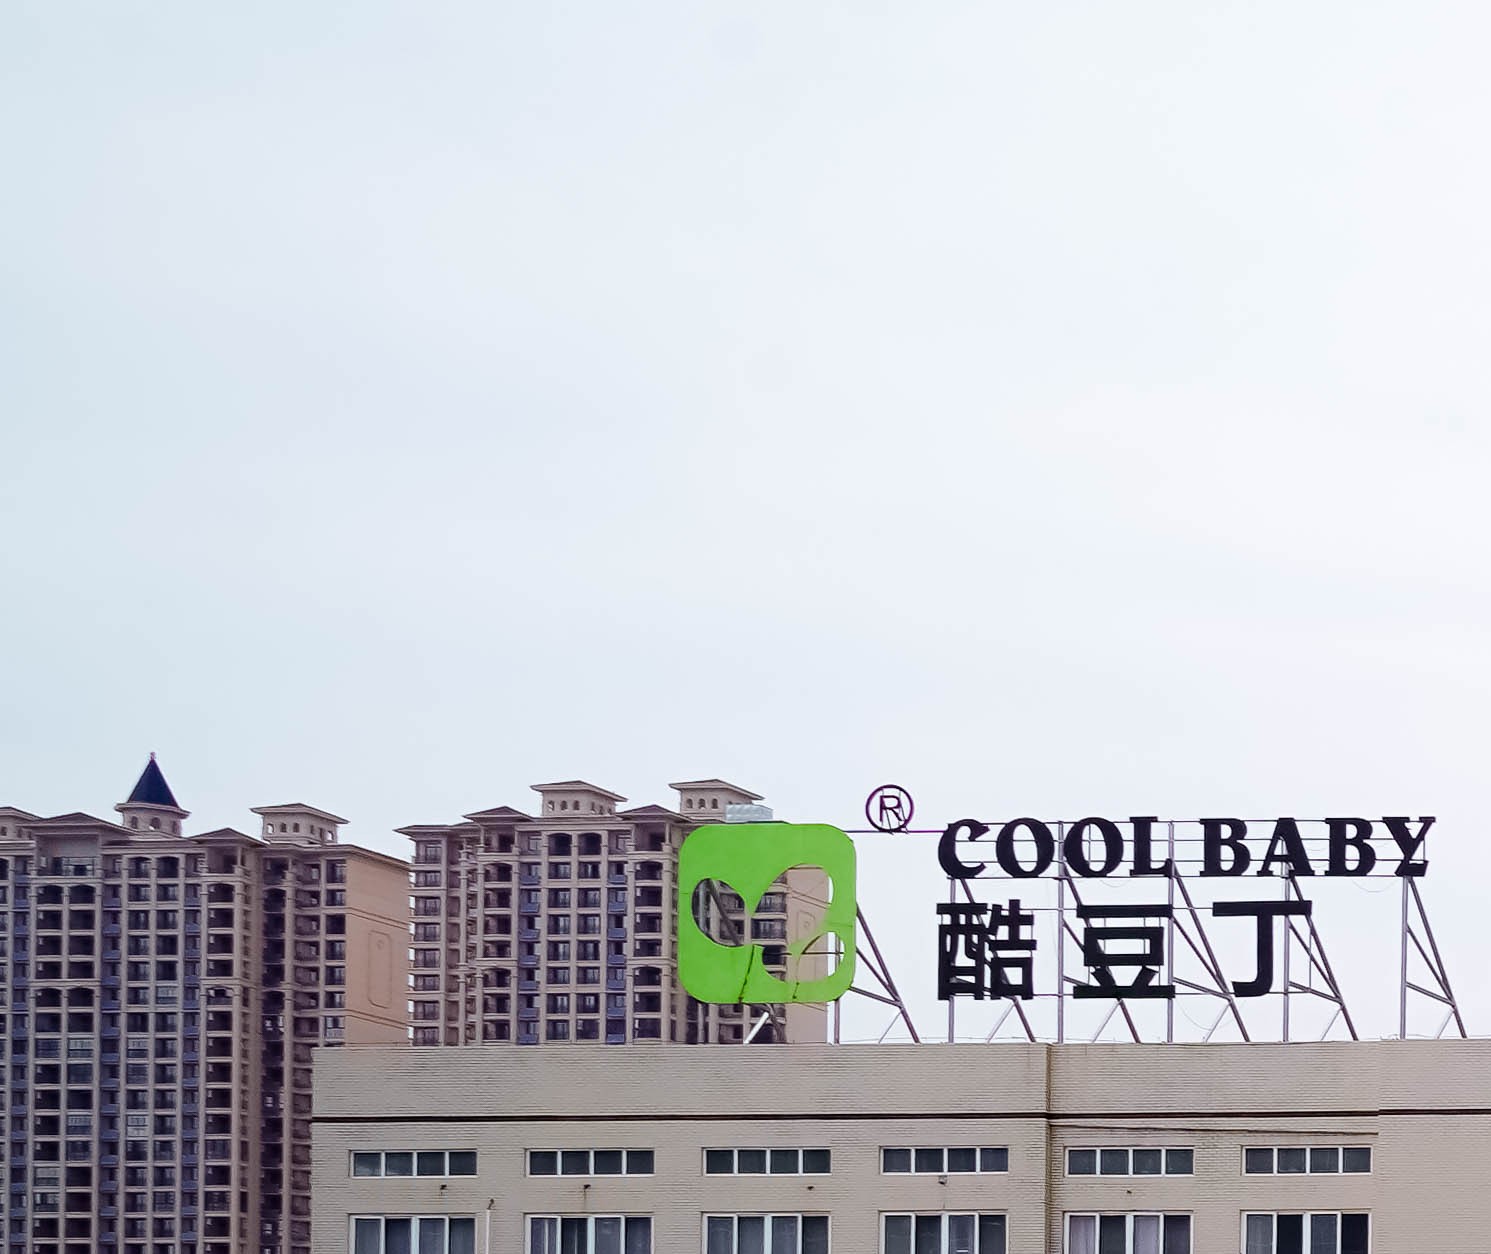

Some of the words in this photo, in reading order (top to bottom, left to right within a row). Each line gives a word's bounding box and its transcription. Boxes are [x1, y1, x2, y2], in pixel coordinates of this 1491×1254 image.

[937, 816, 1175, 879] COOL
[1199, 816, 1437, 878] BABY
[936, 899, 1313, 1001] 酷豆丁
